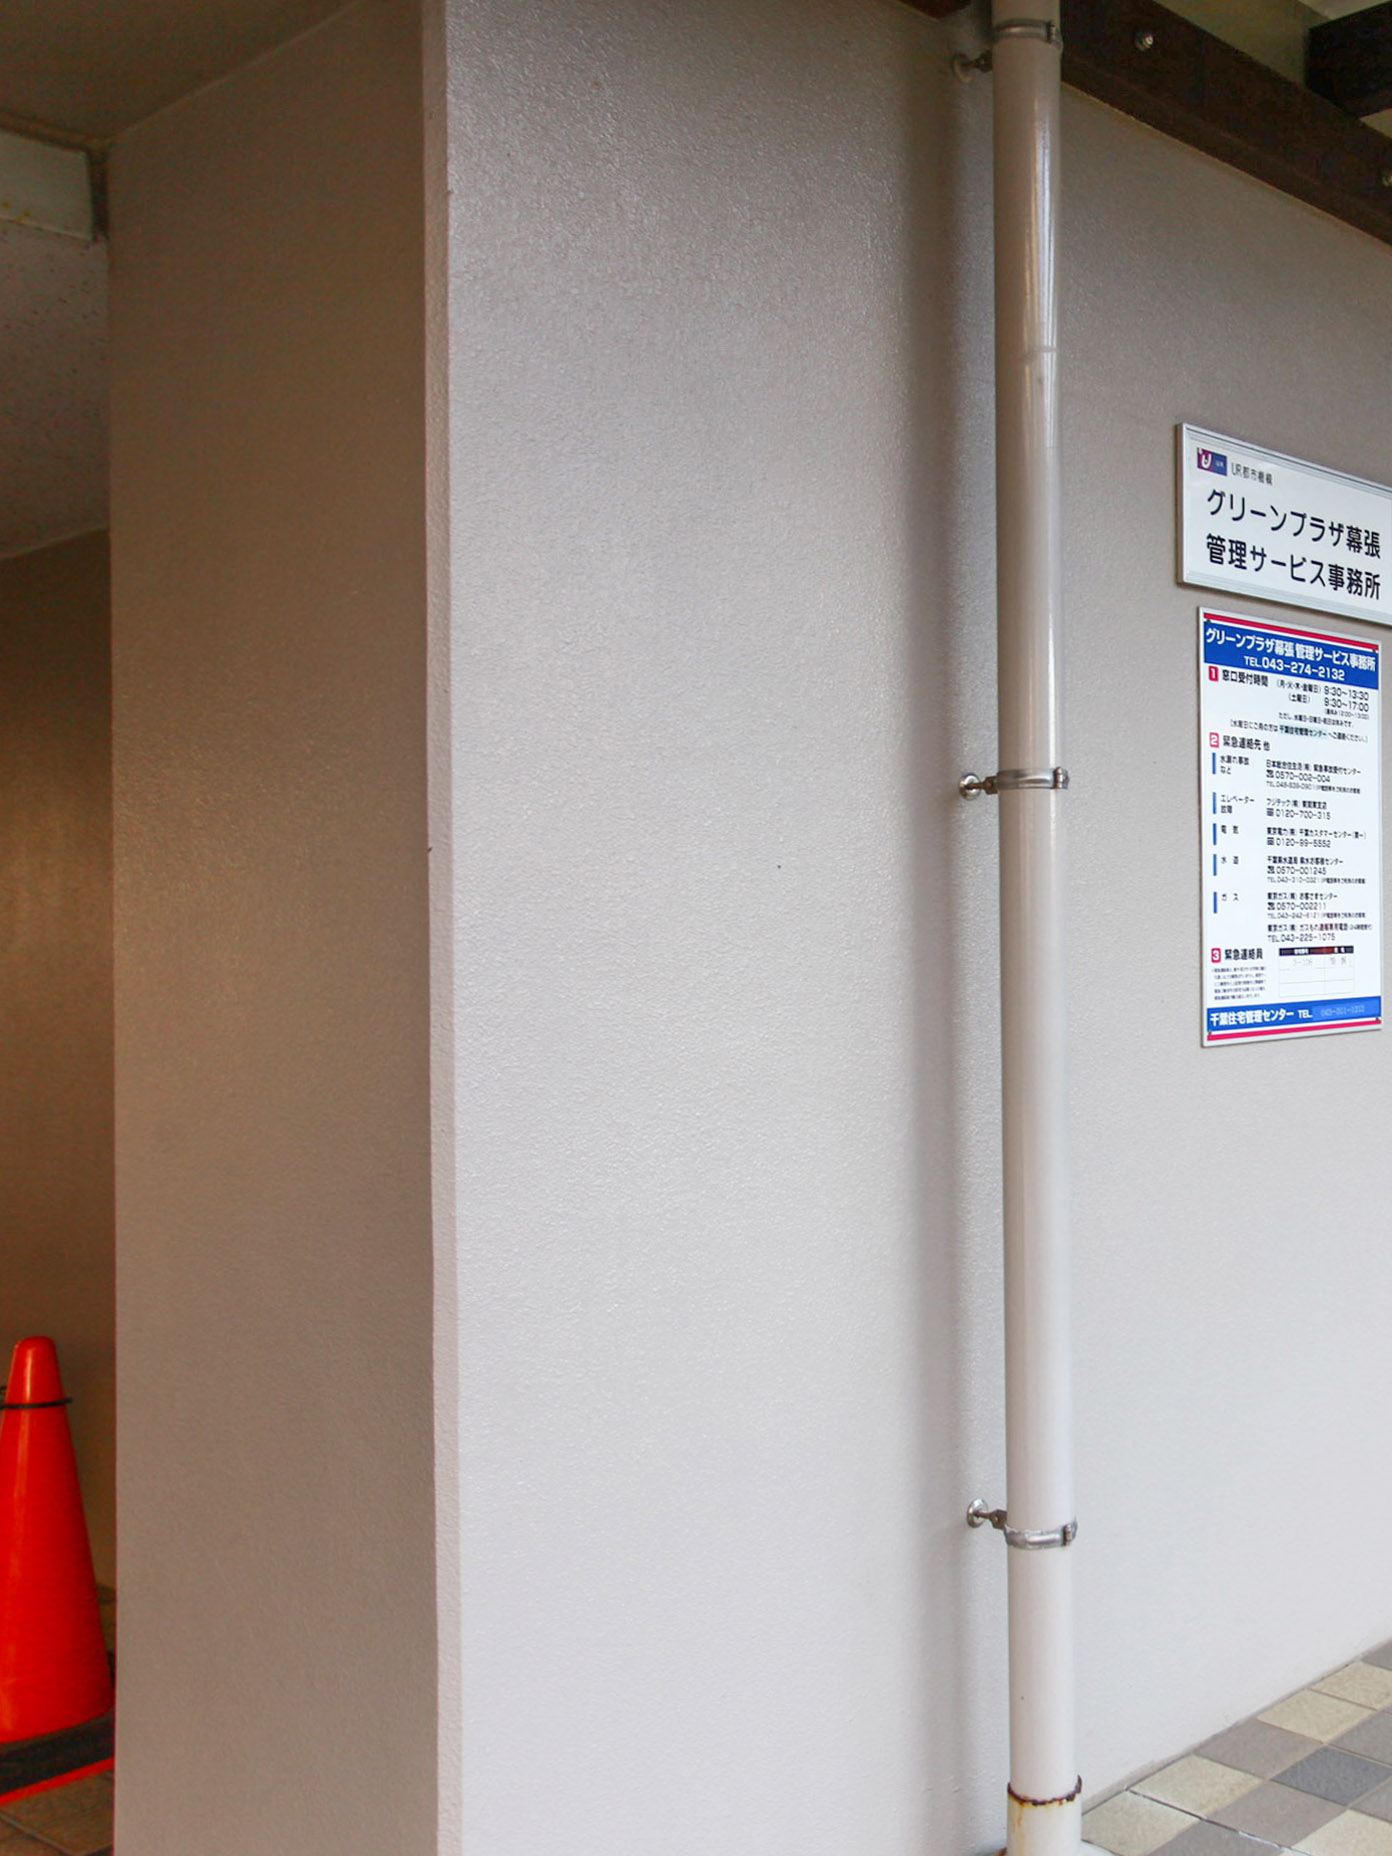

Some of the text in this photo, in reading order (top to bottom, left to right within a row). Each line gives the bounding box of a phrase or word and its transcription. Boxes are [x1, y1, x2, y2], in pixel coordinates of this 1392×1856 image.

[1231, 462, 1273, 486] UR都市機構
[1207, 489, 1381, 559] グリーンプラザ幕張
[1206, 533, 1381, 600] 管理サービス事務所
[1206, 628, 1376, 672] グリーンプラザ幕張 管理サービス事務所
[1222, 669, 1269, 687] 窓口受付時間
[1210, 1008, 1294, 1027] 千葉住宅管理センター
